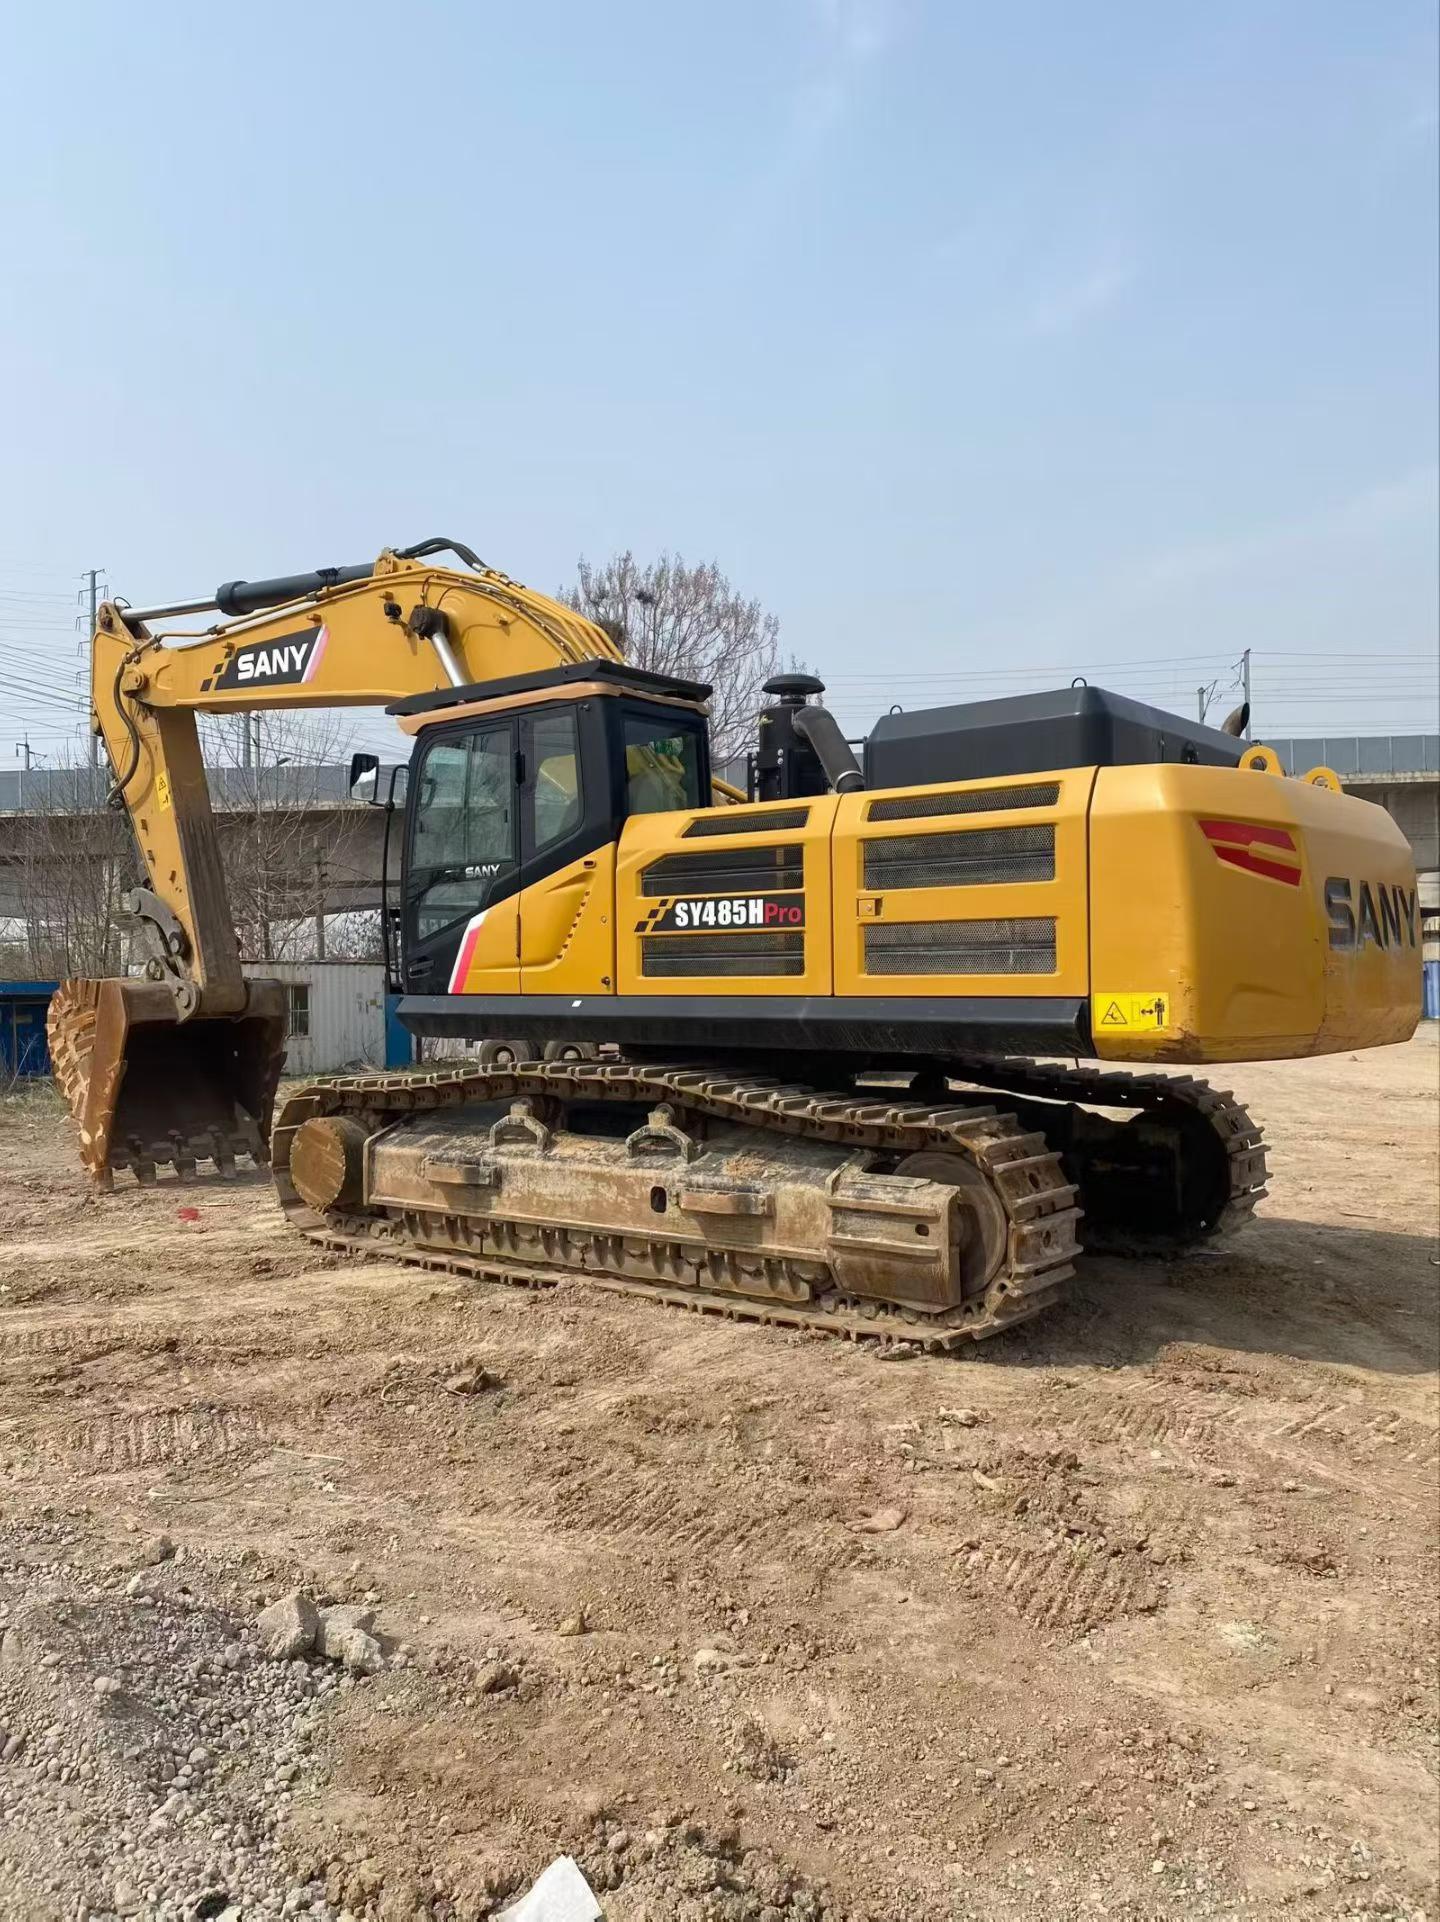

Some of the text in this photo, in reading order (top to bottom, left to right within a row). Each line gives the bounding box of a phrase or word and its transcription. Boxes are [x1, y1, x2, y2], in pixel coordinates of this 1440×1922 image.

[237, 643, 309, 680] SANY
[465, 864, 500, 878] SANY
[1324, 876, 1415, 950] SANY
